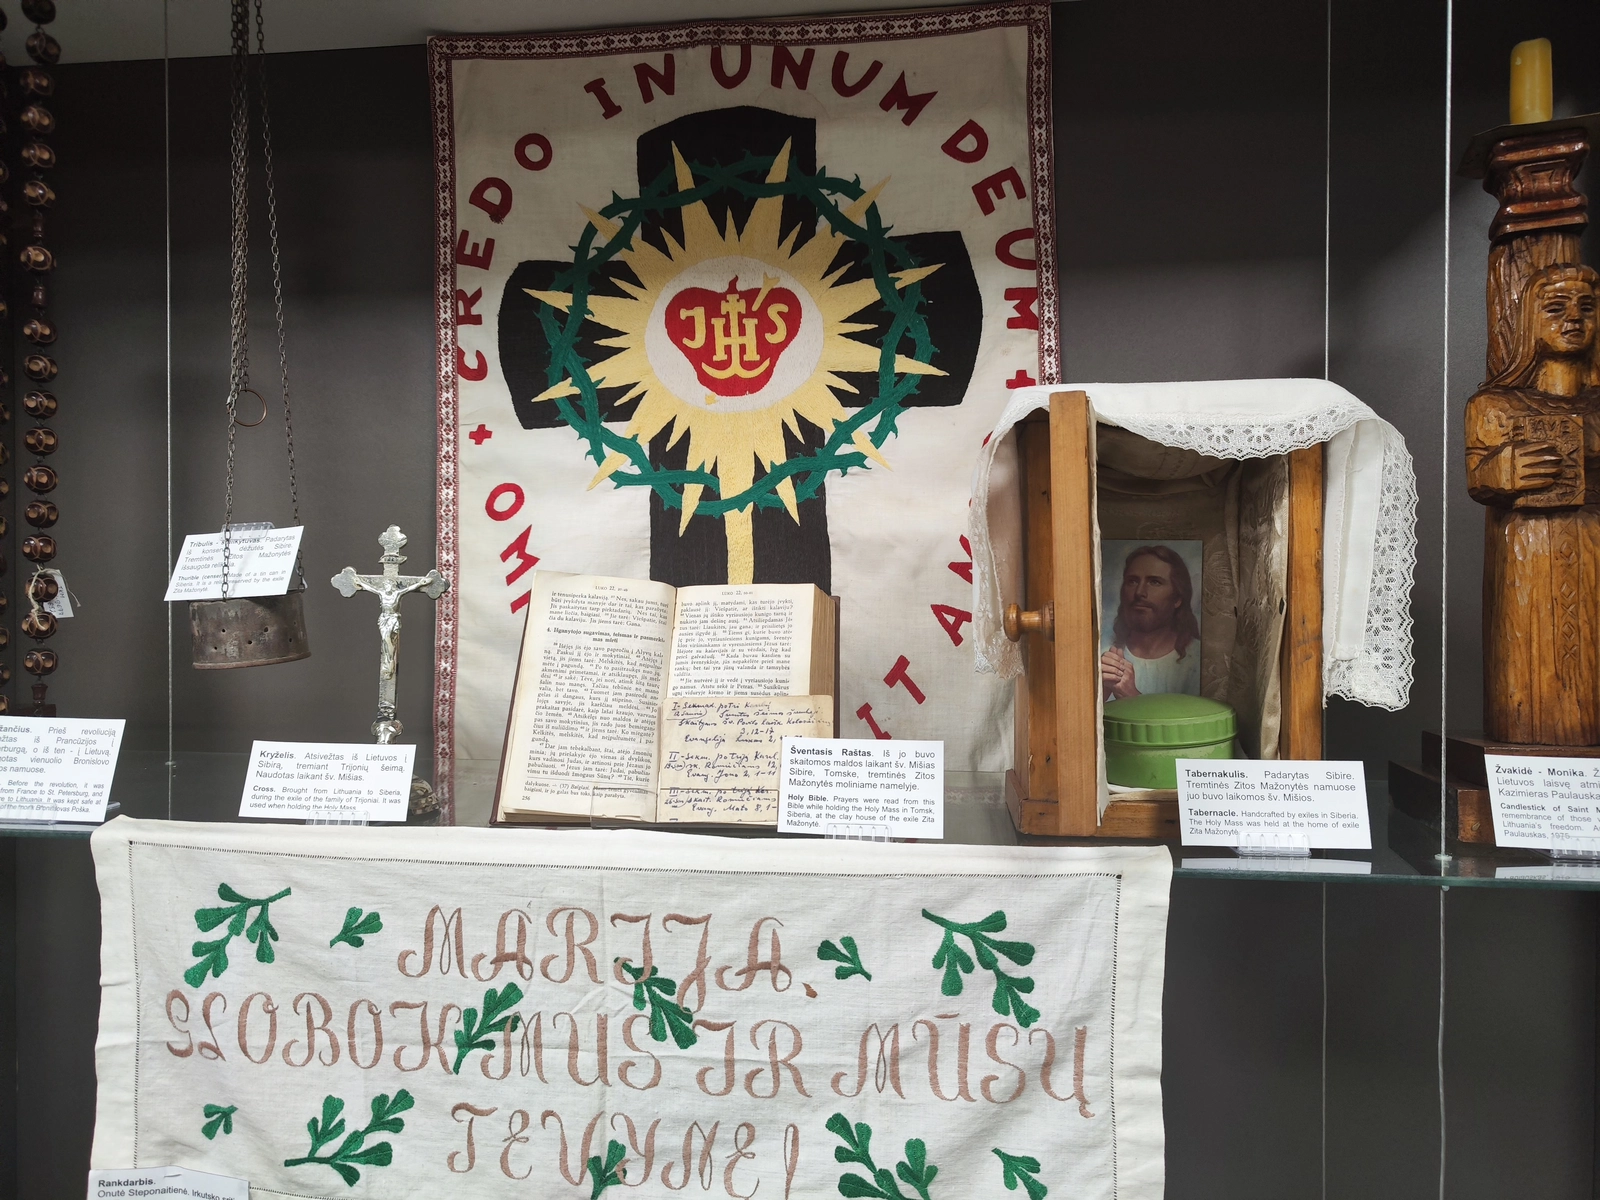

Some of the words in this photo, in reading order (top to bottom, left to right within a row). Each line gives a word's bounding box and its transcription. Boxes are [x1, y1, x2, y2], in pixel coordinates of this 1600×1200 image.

[584, 53, 676, 120] IN
[710, 44, 938, 126] UNUM
[941, 119, 1039, 330] DEUM
[456, 133, 553, 381] CREDO
[259, 750, 296, 760] Kryželis.
[304, 752, 344, 761] Atsivežtas
[352, 753, 358, 761] iš
[366, 754, 398, 762] Lietuvos
[790, 746, 833, 756] Šventasis
[842, 748, 874, 757] Raštas.
[257, 760, 283, 770] Sibirą,
[296, 762, 329, 770] tremiant
[341, 763, 369, 773] Trijonių
[380, 764, 405, 773] šeimą.
[789, 757, 831, 766] skaitomos
[833, 759, 863, 767] maldos
[865, 760, 892, 768] laikant
[894, 760, 906, 768] šv.
[909, 761, 936, 769] Mišias
[255, 770, 295, 780] Naudotas
[296, 772, 323, 780] laikant
[324, 772, 335, 780] šv.
[338, 773, 364, 781] Mišias.
[789, 767, 815, 777] Sibire,
[824, 768, 859, 779] Tomske,
[868, 771, 906, 779] tremtinės
[915, 771, 935, 780] Zitos
[1184, 769, 1248, 778] Tabernakulis.
[1264, 770, 1309, 781] Padarytas
[1326, 771, 1354, 780] Sibire.
[1495, 764, 1533, 775] Žvakidė
[1547, 768, 1587, 777] Monika.
[788, 778, 833, 789] Mažonytės
[836, 780, 878, 789] moliniame
[880, 782, 919, 792] namelyje.
[1186, 780, 1230, 790] Tremtinės
[1234, 781, 1256, 790] Zitos
[1260, 782, 1309, 792] Mažonytės
[1496, 777, 1535, 786] Lietuvos
[1543, 779, 1571, 790] laisvę
[252, 785, 276, 793] Cross.
[282, 786, 308, 795] Brought
[1498, 788, 1549, 798] Kazimieras
[251, 793, 273, 802] during
[286, 794, 303, 802] exile
[325, 796, 344, 804] family
[354, 796, 380, 804] Trijoniai.
[788, 794, 804, 803] Holy
[808, 794, 829, 802] Bible.
[833, 795, 859, 804] Prayers
[1186, 791, 1200, 802] juo
[1202, 792, 1224, 800] buvo
[1226, 792, 1265, 801] laikomos
[1268, 793, 1280, 801] šv.
[1283, 793, 1314, 802] Mišios.
[825, 803, 850, 813] holding
[864, 805, 880, 814] Holy
[910, 806, 935, 815] Tomsk,
[1500, 802, 1546, 811] Candlestick
[787, 810, 812, 819] Siberia,
[825, 812, 836, 820] the
[838, 812, 853, 822] clay
[1188, 808, 1239, 817] Tabernacle.
[1241, 810, 1285, 818] Handcrafted
[1287, 811, 1296, 819] by
[1501, 813, 1552, 821] remembrance
[786, 819, 820, 828] Mažonytė.
[1188, 818, 1203, 828] The
[1205, 818, 1222, 828] Holy
[1224, 819, 1244, 827] Mass
[1502, 820, 1542, 830] Lithuania's
[1550, 823, 1584, 831] freedom.
[1189, 827, 1203, 835] Zita
[1504, 829, 1549, 839] Paulauskas,
[480, 1010, 662, 1091] MUS
[830, 1012, 1095, 1118] MŪSŲ
[98, 1178, 156, 1187] Rankdarbis.
[98, 1189, 125, 1198] Onutė
[128, 1186, 190, 1197] Steponaitienė.
